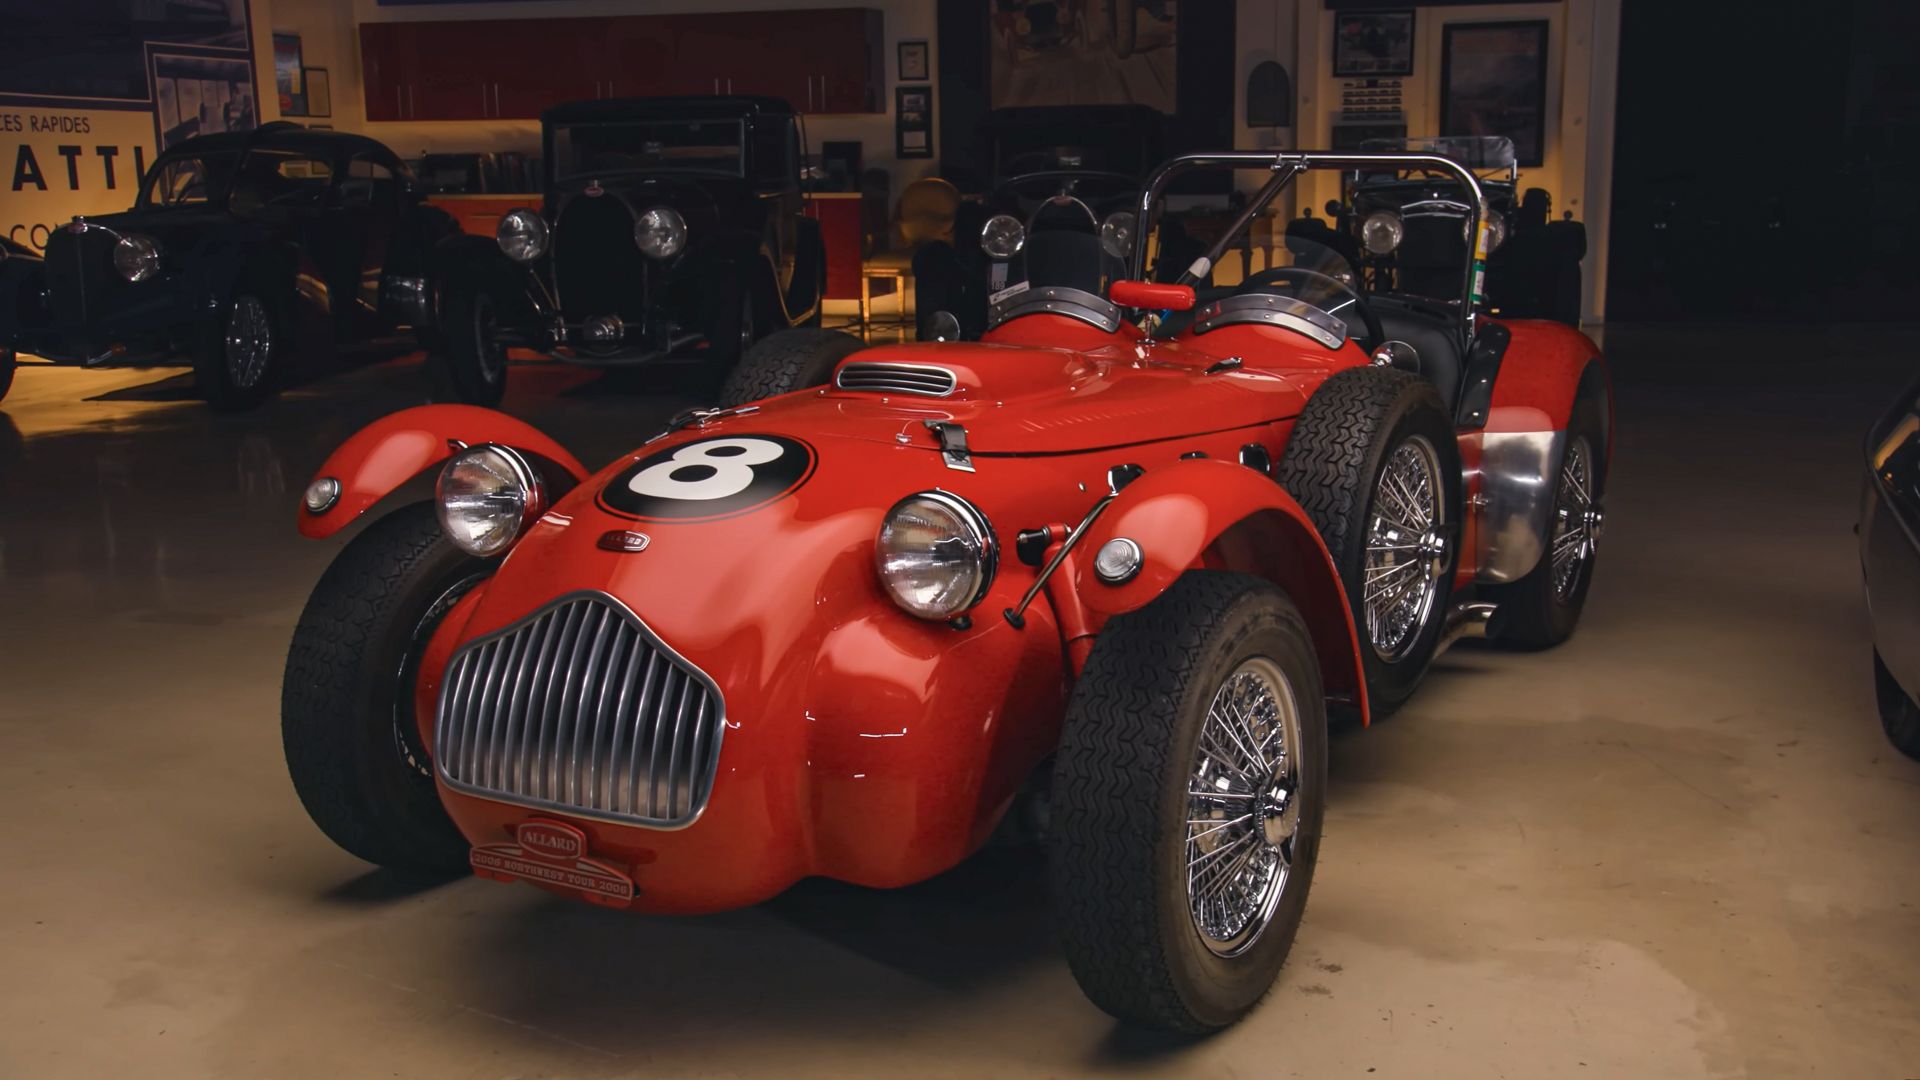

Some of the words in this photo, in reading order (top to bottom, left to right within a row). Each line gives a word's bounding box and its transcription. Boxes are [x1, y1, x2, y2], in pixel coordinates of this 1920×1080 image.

[30, 115, 90, 133] RAPIDES
[628, 437, 784, 500] 8
[523, 831, 577, 851] ALLARD
[504, 858, 565, 881] NORTHWEST
[567, 873, 596, 888] TOUR
